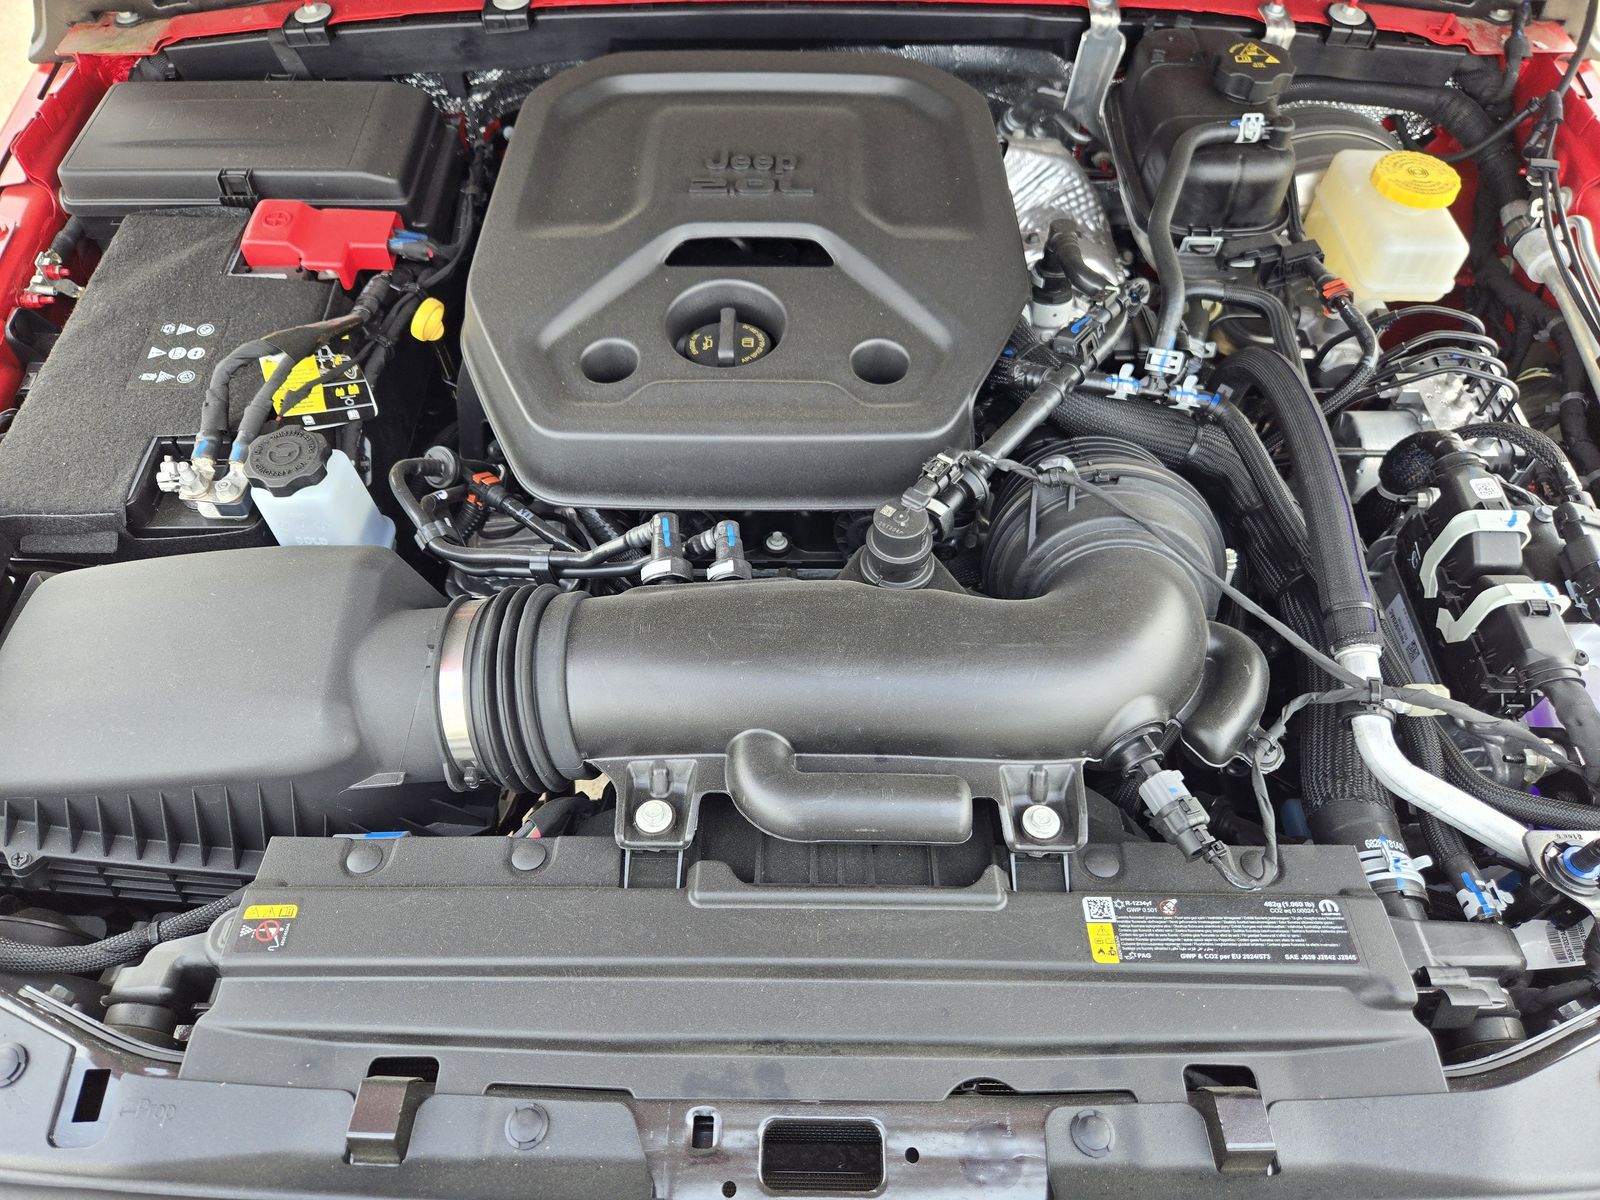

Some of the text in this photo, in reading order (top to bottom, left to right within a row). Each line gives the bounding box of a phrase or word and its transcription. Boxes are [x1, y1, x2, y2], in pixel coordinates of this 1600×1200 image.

[705, 151, 797, 176] Jeep
[689, 177, 815, 198] 2.0L
[135, 1098, 176, 1125] Prop
